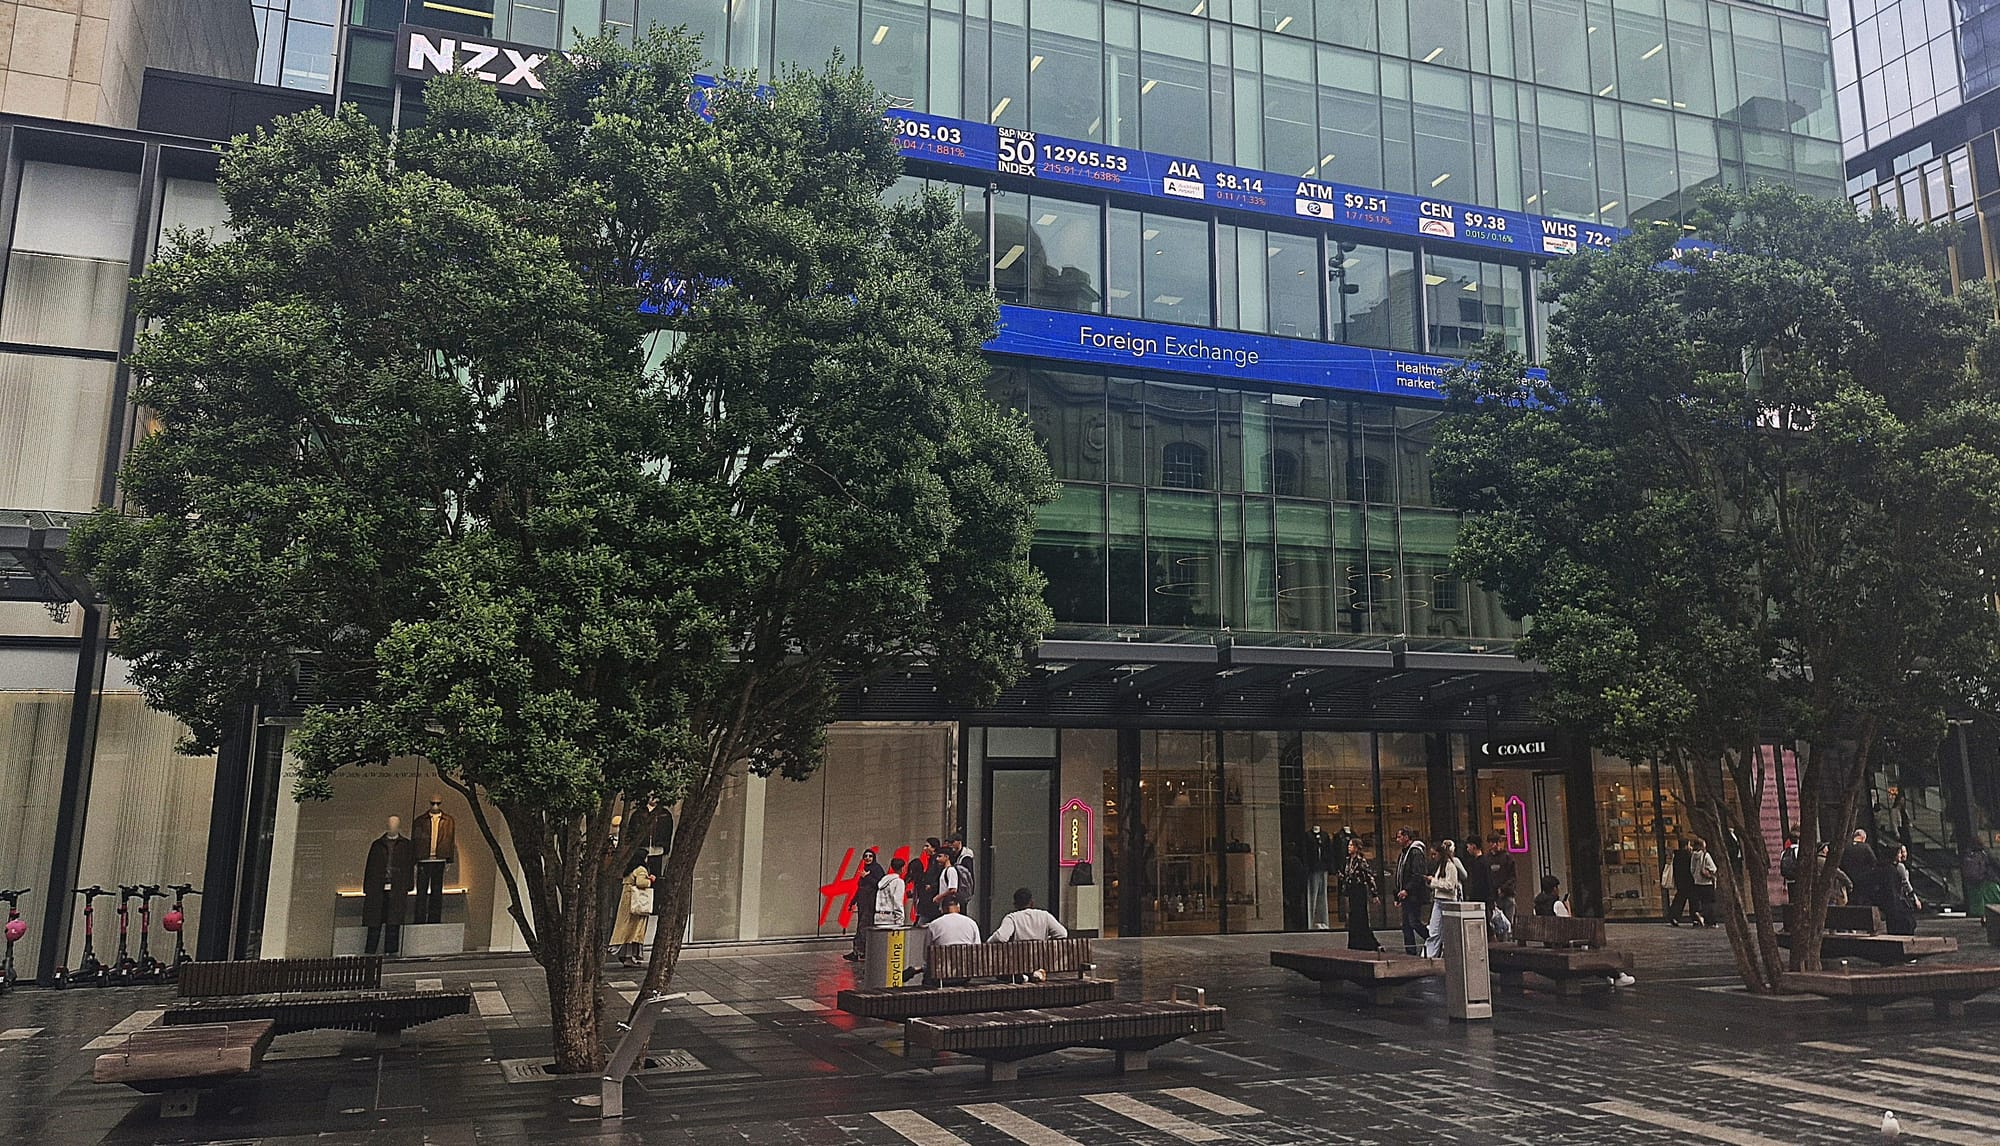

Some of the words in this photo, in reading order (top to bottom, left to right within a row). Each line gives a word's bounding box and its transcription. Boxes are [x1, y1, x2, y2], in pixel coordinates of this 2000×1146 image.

[408, 33, 548, 91] NZX
[927, 143, 966, 158] 1.881%
[998, 137, 1035, 165] 50
[1043, 145, 1128, 172] 12965.53
[998, 161, 1036, 177] INDEX
[1043, 162, 1075, 174] 215.91
[1086, 169, 1121, 183] 1.638%
[1167, 161, 1201, 180] AIA
[1216, 172, 1263, 193] $8.14
[1295, 182, 1333, 200] ATM
[1344, 192, 1387, 213] $9.51
[1420, 201, 1453, 219] CEN
[1464, 211, 1506, 231] $9.38
[1541, 219, 1578, 238] WHS
[1465, 229, 1486, 240] 0.015
[1491, 233, 1514, 243] 0.16%
[1079, 326, 1158, 357] Foreign
[1164, 335, 1260, 368] Exchange
[1497, 741, 1546, 756] COACH
